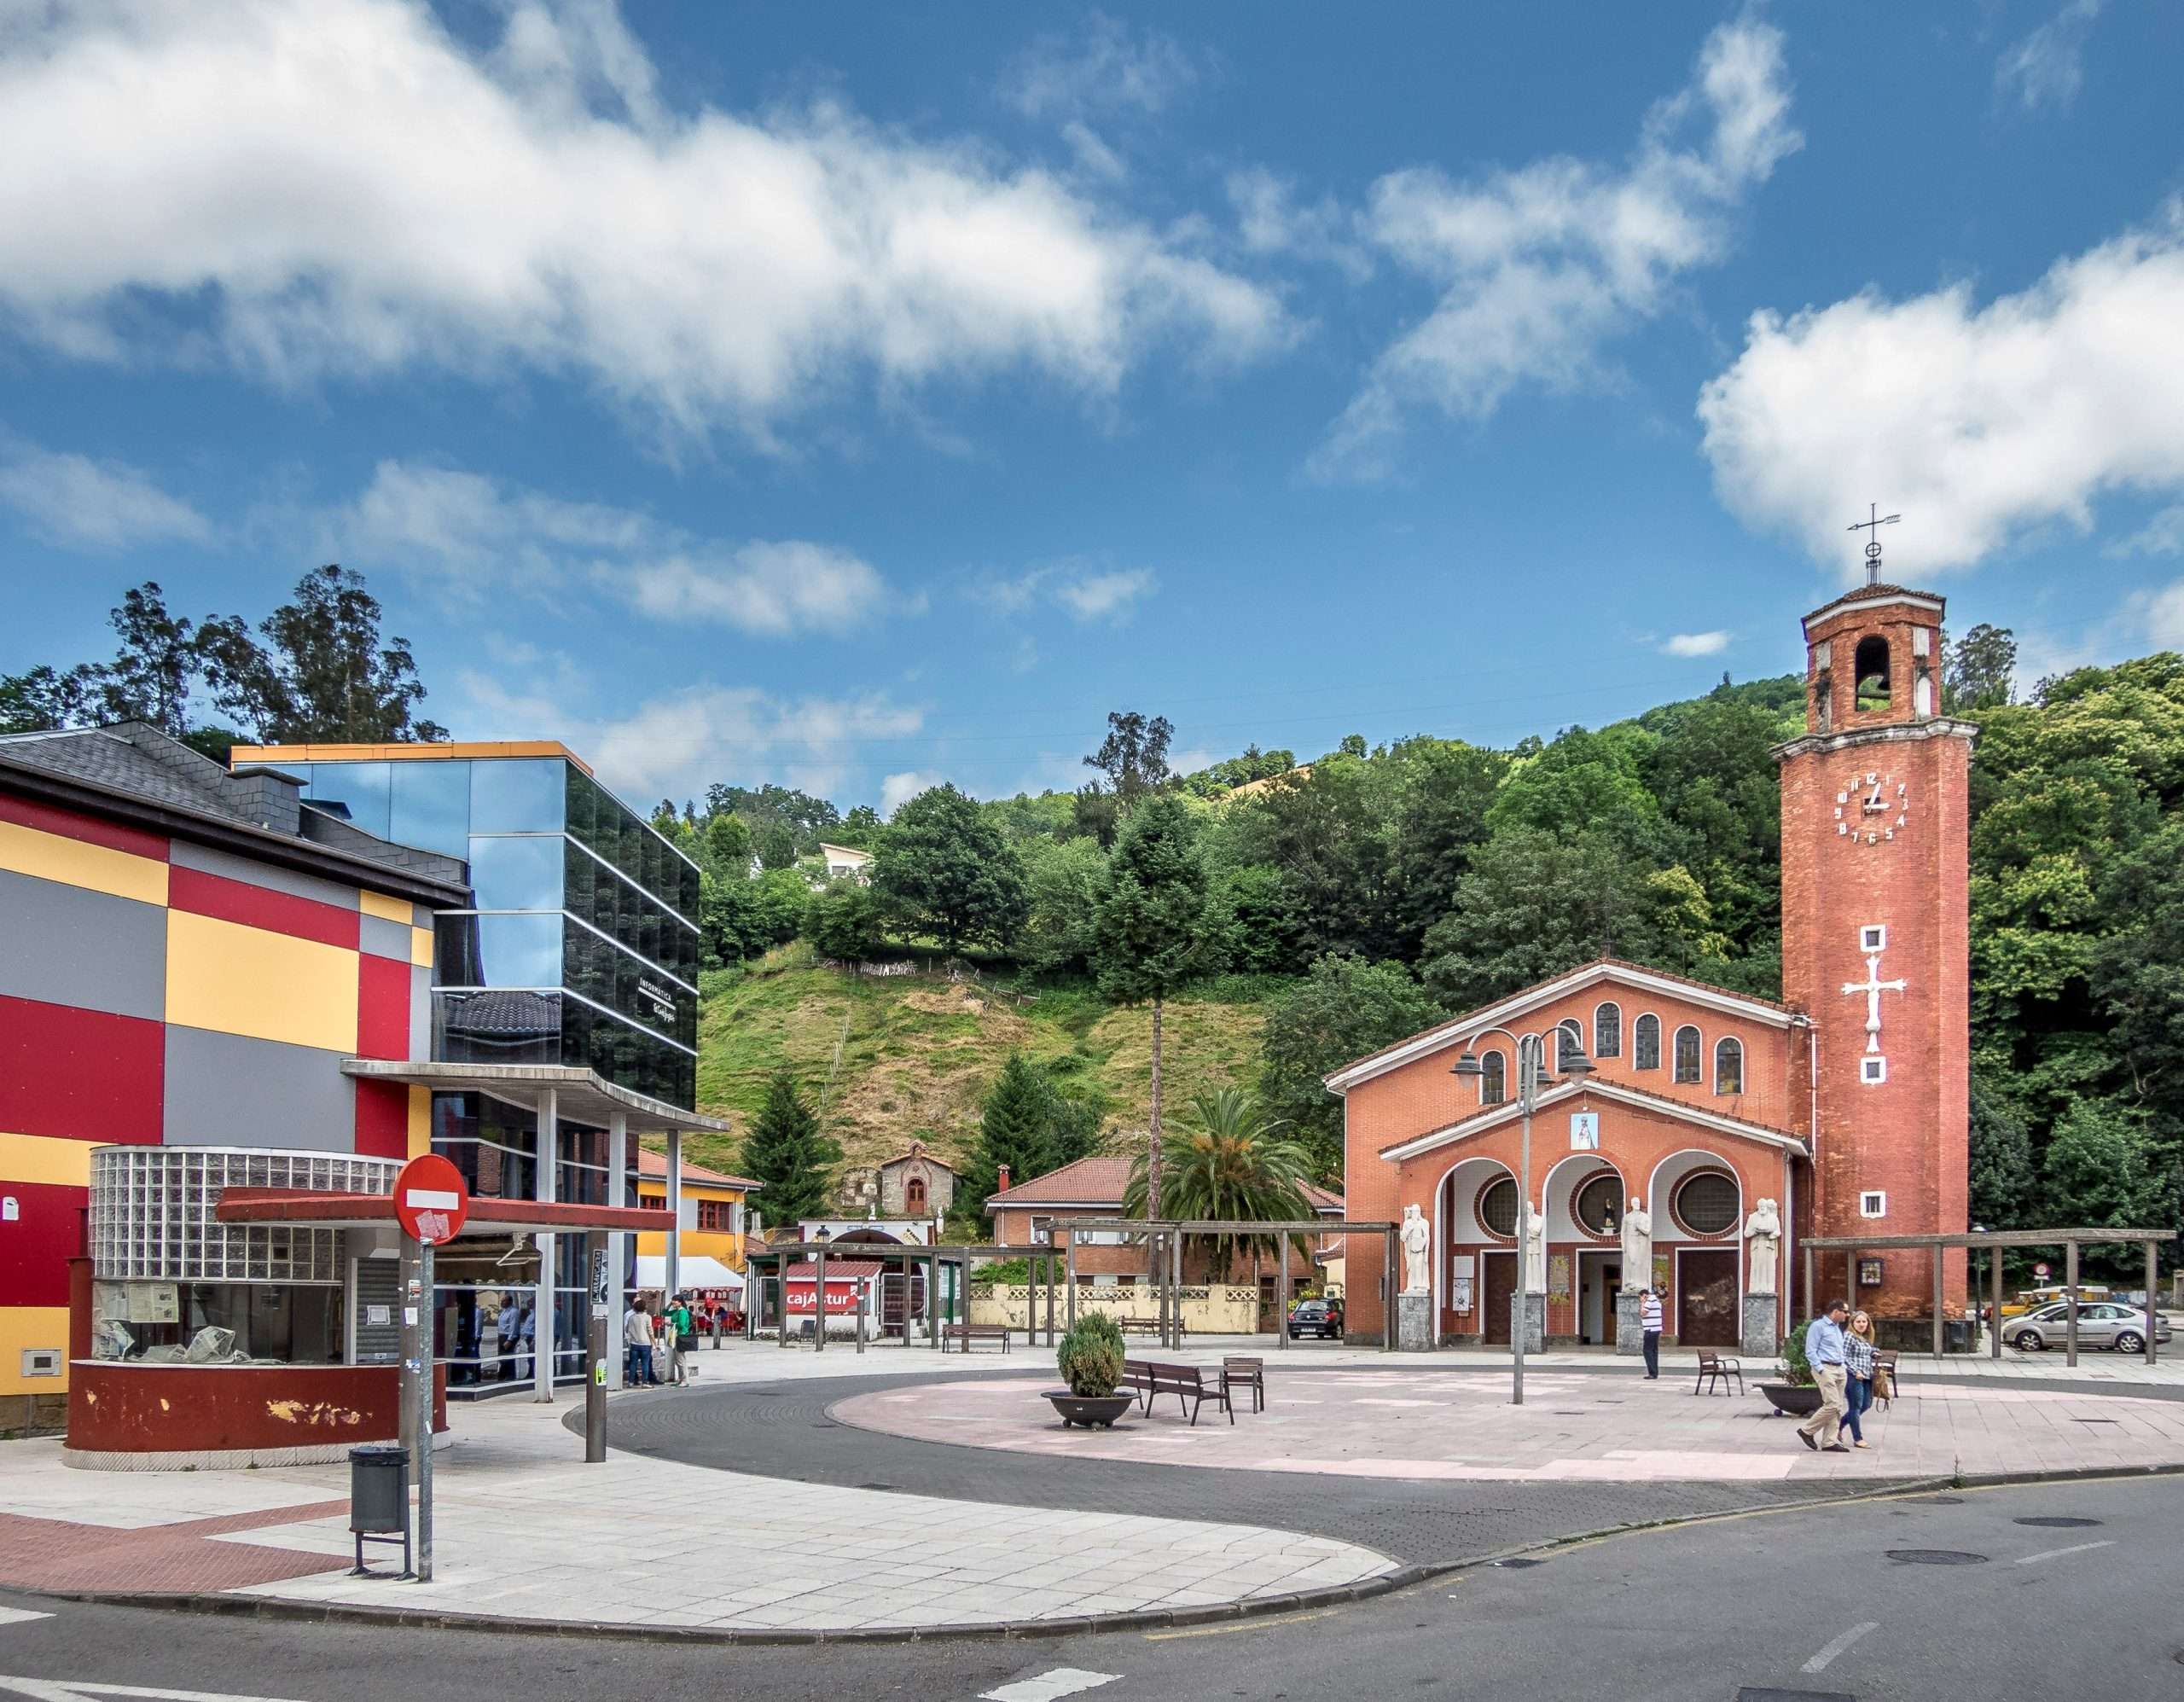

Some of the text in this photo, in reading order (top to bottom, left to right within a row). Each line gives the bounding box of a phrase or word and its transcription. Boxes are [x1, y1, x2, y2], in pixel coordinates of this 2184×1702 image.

[1866, 772, 1878, 786] 12
[1850, 780, 1859, 792] 11
[1897, 783, 1906, 796] 2
[1837, 791, 1848, 804] 10
[1902, 799, 1909, 810] 3
[1834, 807, 1842, 820] 9
[1896, 814, 1905, 827] 4
[1838, 822, 1847, 835] 8
[1885, 828, 1893, 840] 5
[1851, 831, 1859, 843] 7
[1868, 832, 1877, 844] 6
[786, 1291, 849, 1308] cajAtur
